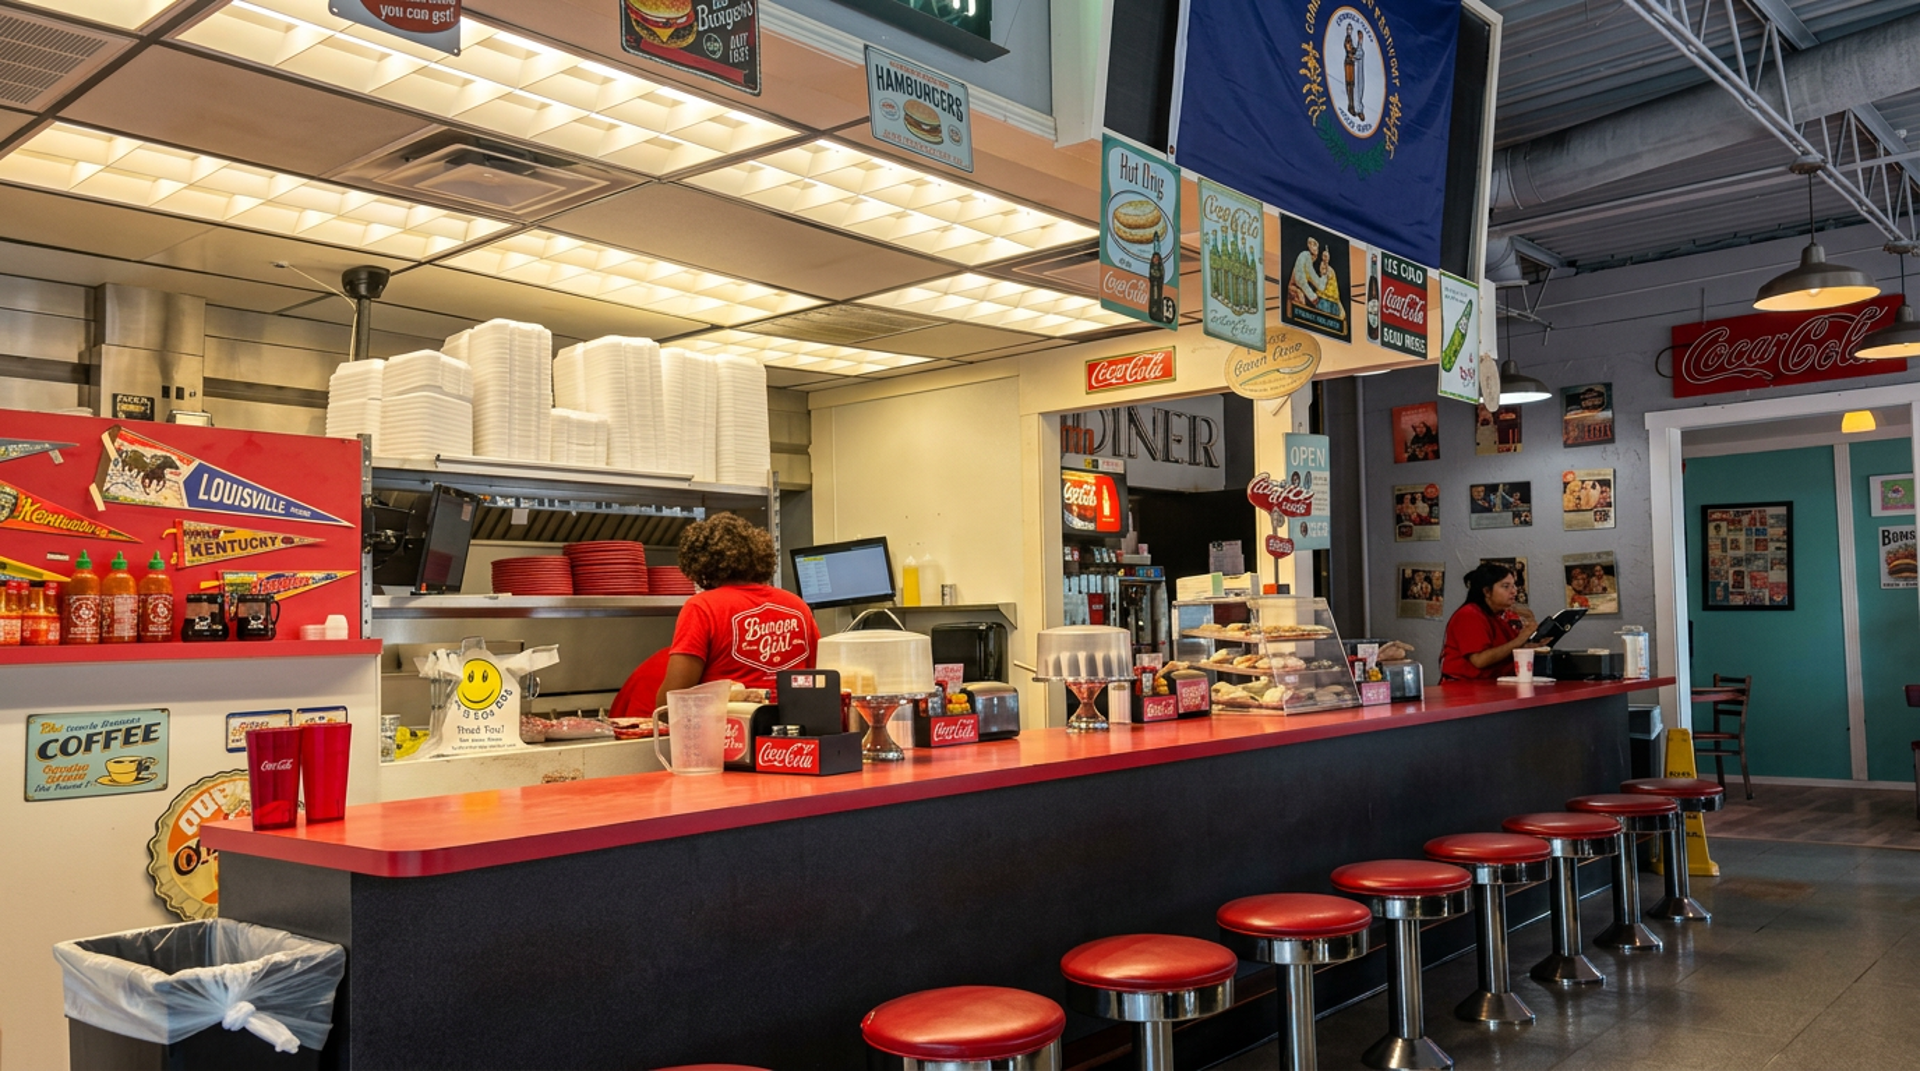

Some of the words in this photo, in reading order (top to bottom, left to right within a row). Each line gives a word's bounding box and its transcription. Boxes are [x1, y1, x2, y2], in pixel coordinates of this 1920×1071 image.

[380, 4, 403, 20] you
[406, 9, 429, 20] can
[875, 63, 963, 123] HAMBURGERS
[1085, 404, 1220, 468] DINER
[1290, 445, 1325, 467] OPEN
[198, 473, 286, 514] LOUISVILLE
[760, 632, 792, 662] Girl
[37, 722, 161, 761] COFFEE
